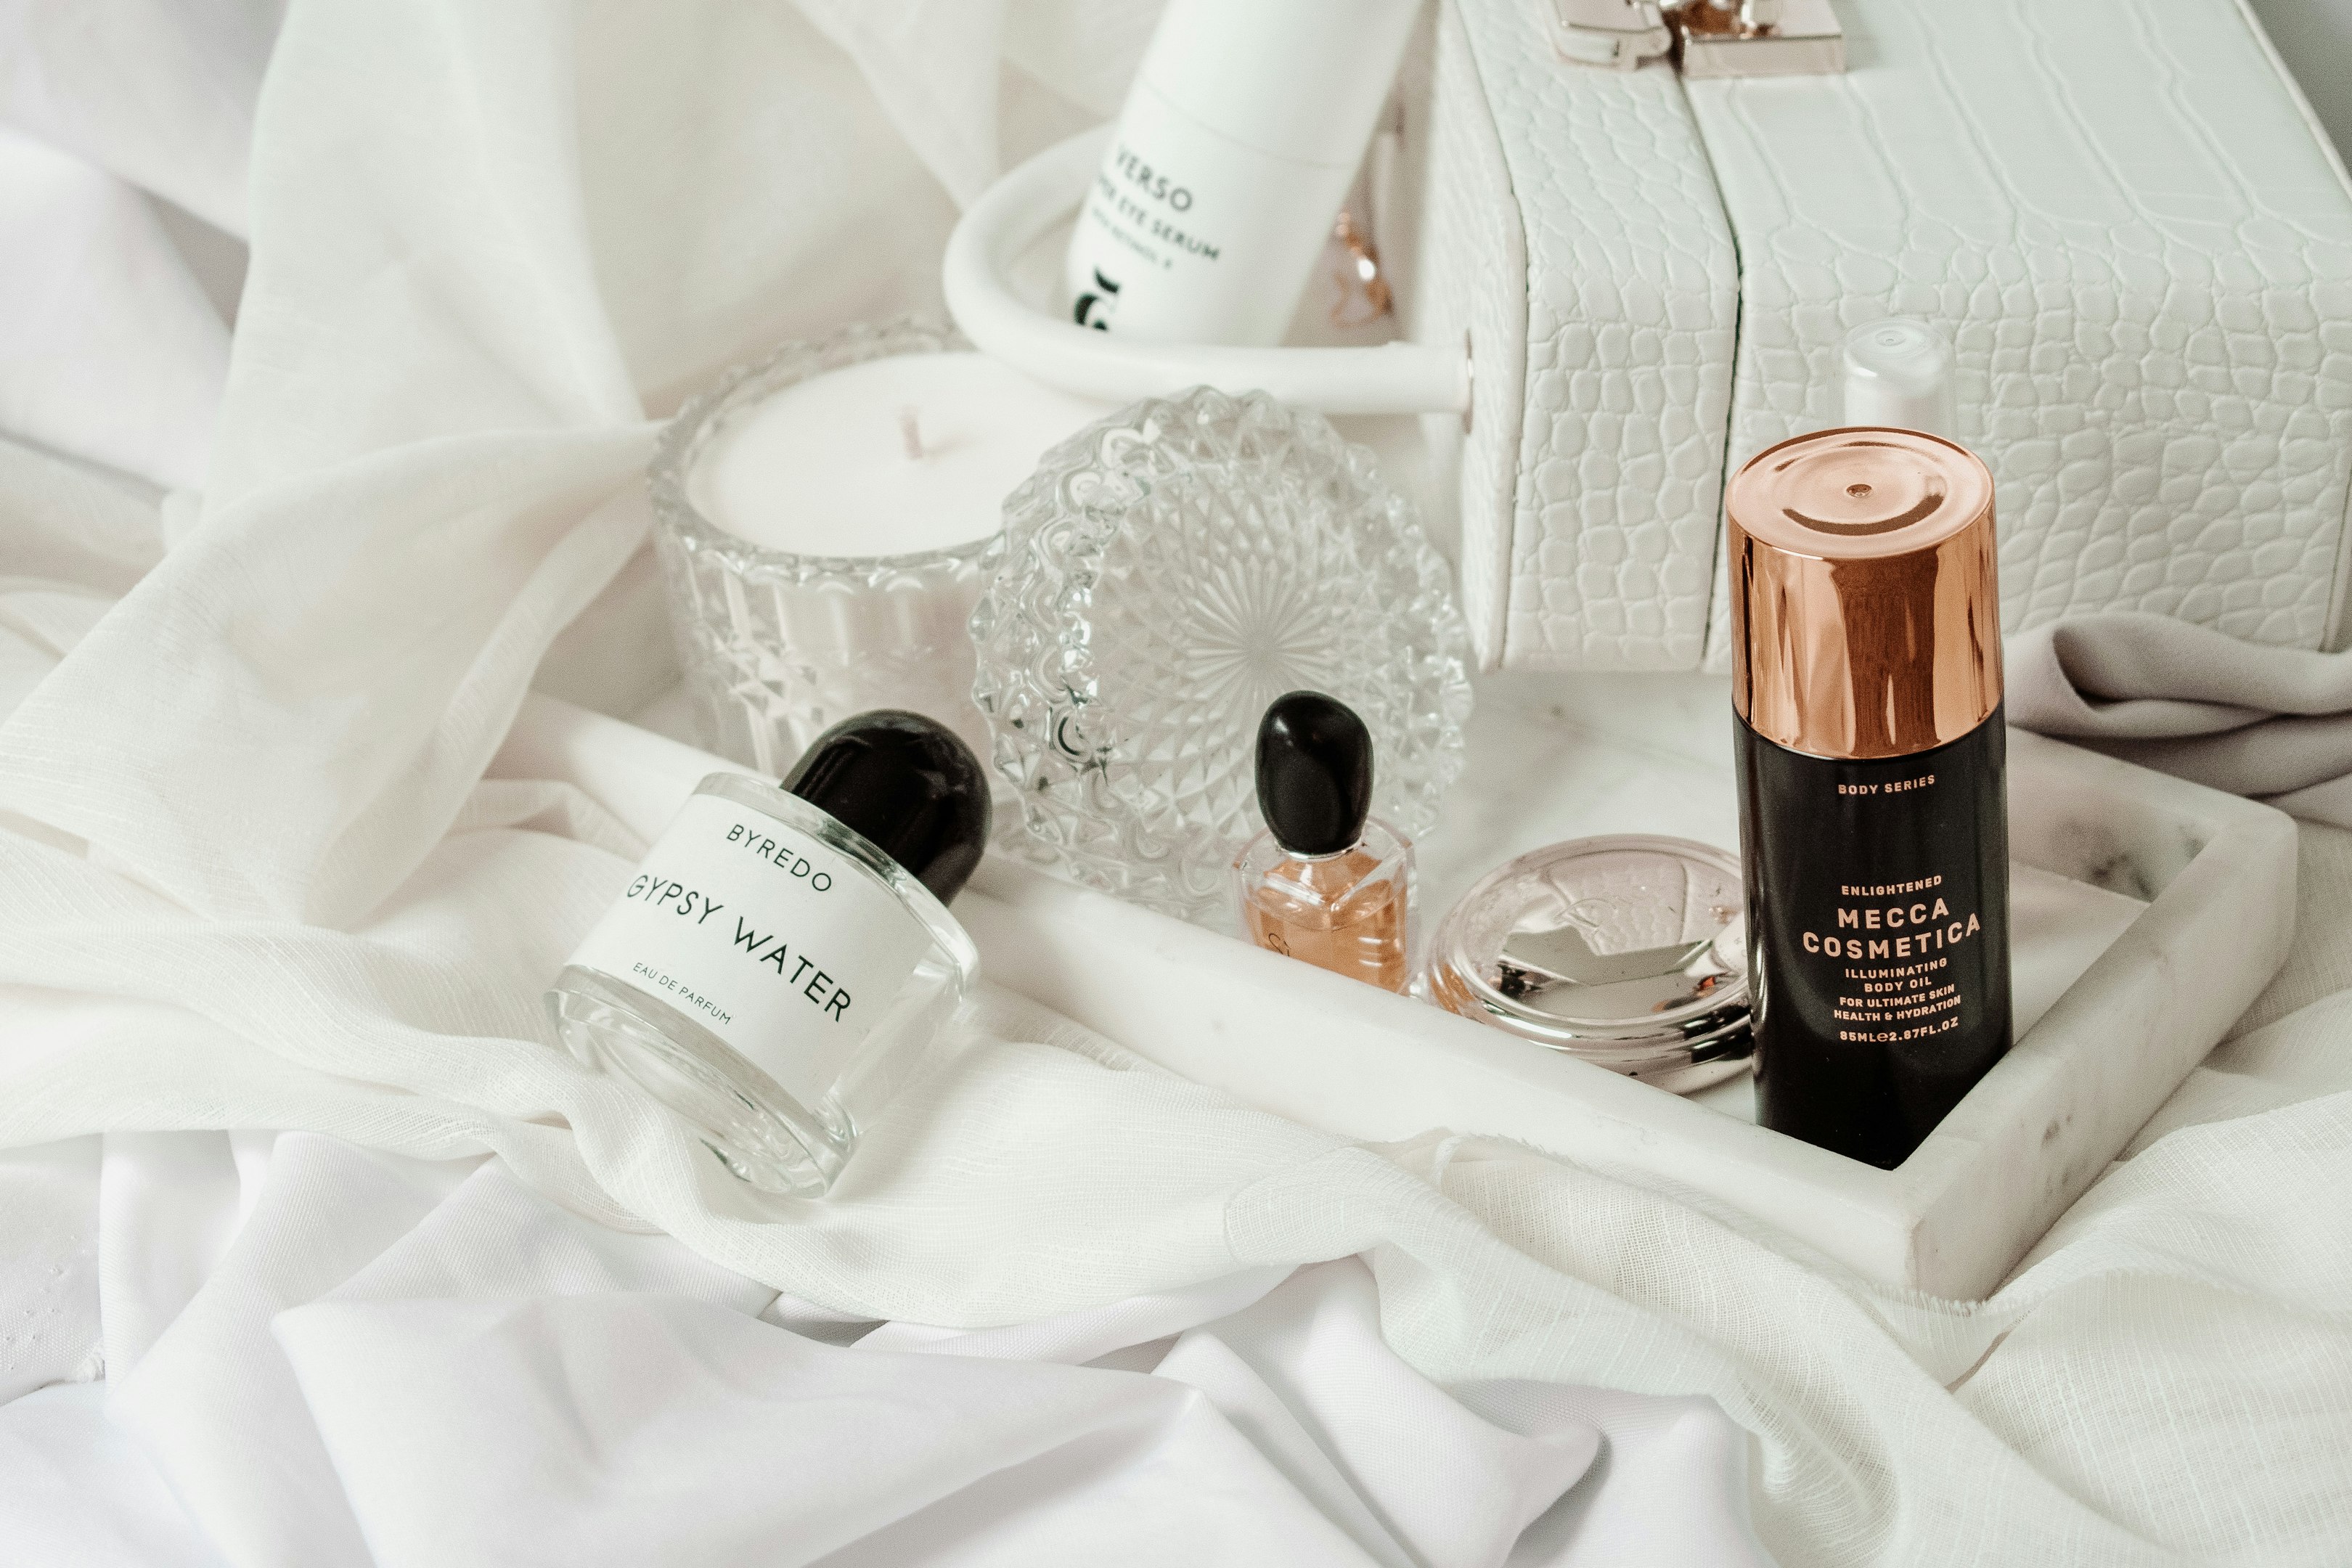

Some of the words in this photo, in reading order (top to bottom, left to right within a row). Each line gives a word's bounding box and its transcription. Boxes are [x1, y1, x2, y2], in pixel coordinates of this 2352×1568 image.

[1116, 146, 1193, 212] VERSO
[1151, 219, 1220, 261] SERUM
[1838, 784, 1878, 795] BODY
[1885, 775, 1935, 793] SERIES
[726, 823, 833, 892] BYREDO
[1841, 875, 1943, 897] ENLIGHTENED
[1837, 897, 1949, 929] MECCA
[626, 874, 724, 925] GYPSY
[734, 915, 852, 1023] WATER
[1802, 912, 1980, 960] COSMETICA
[1845, 957, 1948, 979] ILLUMINATING
[632, 962, 657, 980] EAU
[658, 974, 678, 991] DE
[679, 986, 732, 1026] PARFUM
[1839, 997, 1863, 1008] FOR
[1866, 992, 1926, 1008] ULTIMATE
[1929, 983, 1956, 1000] SKIN
[1864, 981, 1903, 993] BODY
[1909, 976, 1932, 989] OIL
[1834, 1009, 1881, 1021] HEALTH
[1885, 1012, 1893, 1021] &
[1896, 995, 1961, 1021] HYDRATION
